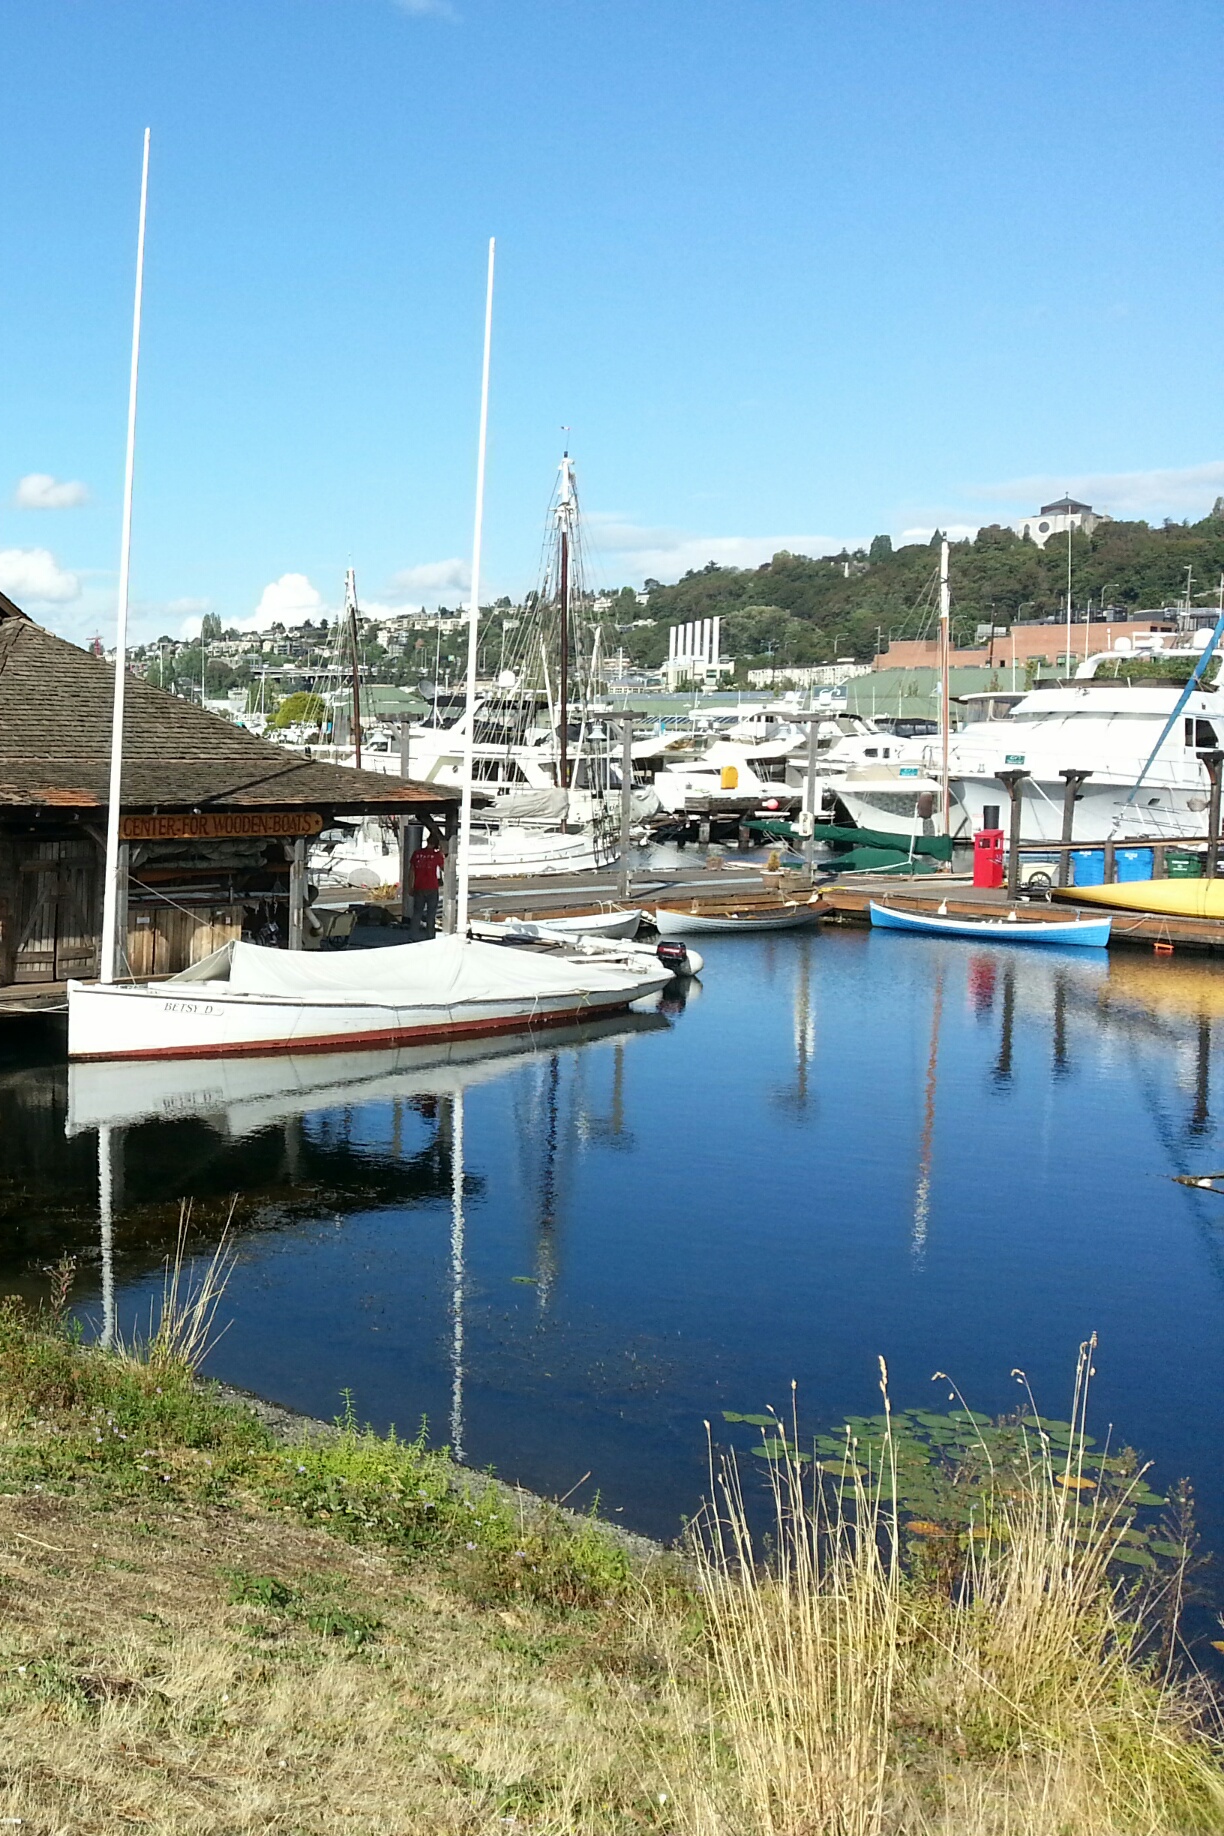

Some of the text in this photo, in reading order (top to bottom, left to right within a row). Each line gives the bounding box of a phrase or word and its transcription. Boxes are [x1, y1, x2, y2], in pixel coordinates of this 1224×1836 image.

[182, 815, 209, 835] FOR
[213, 815, 268, 834] WOODEN
[272, 814, 312, 833] BOATS
[164, 1002, 213, 1014] BETSY D
